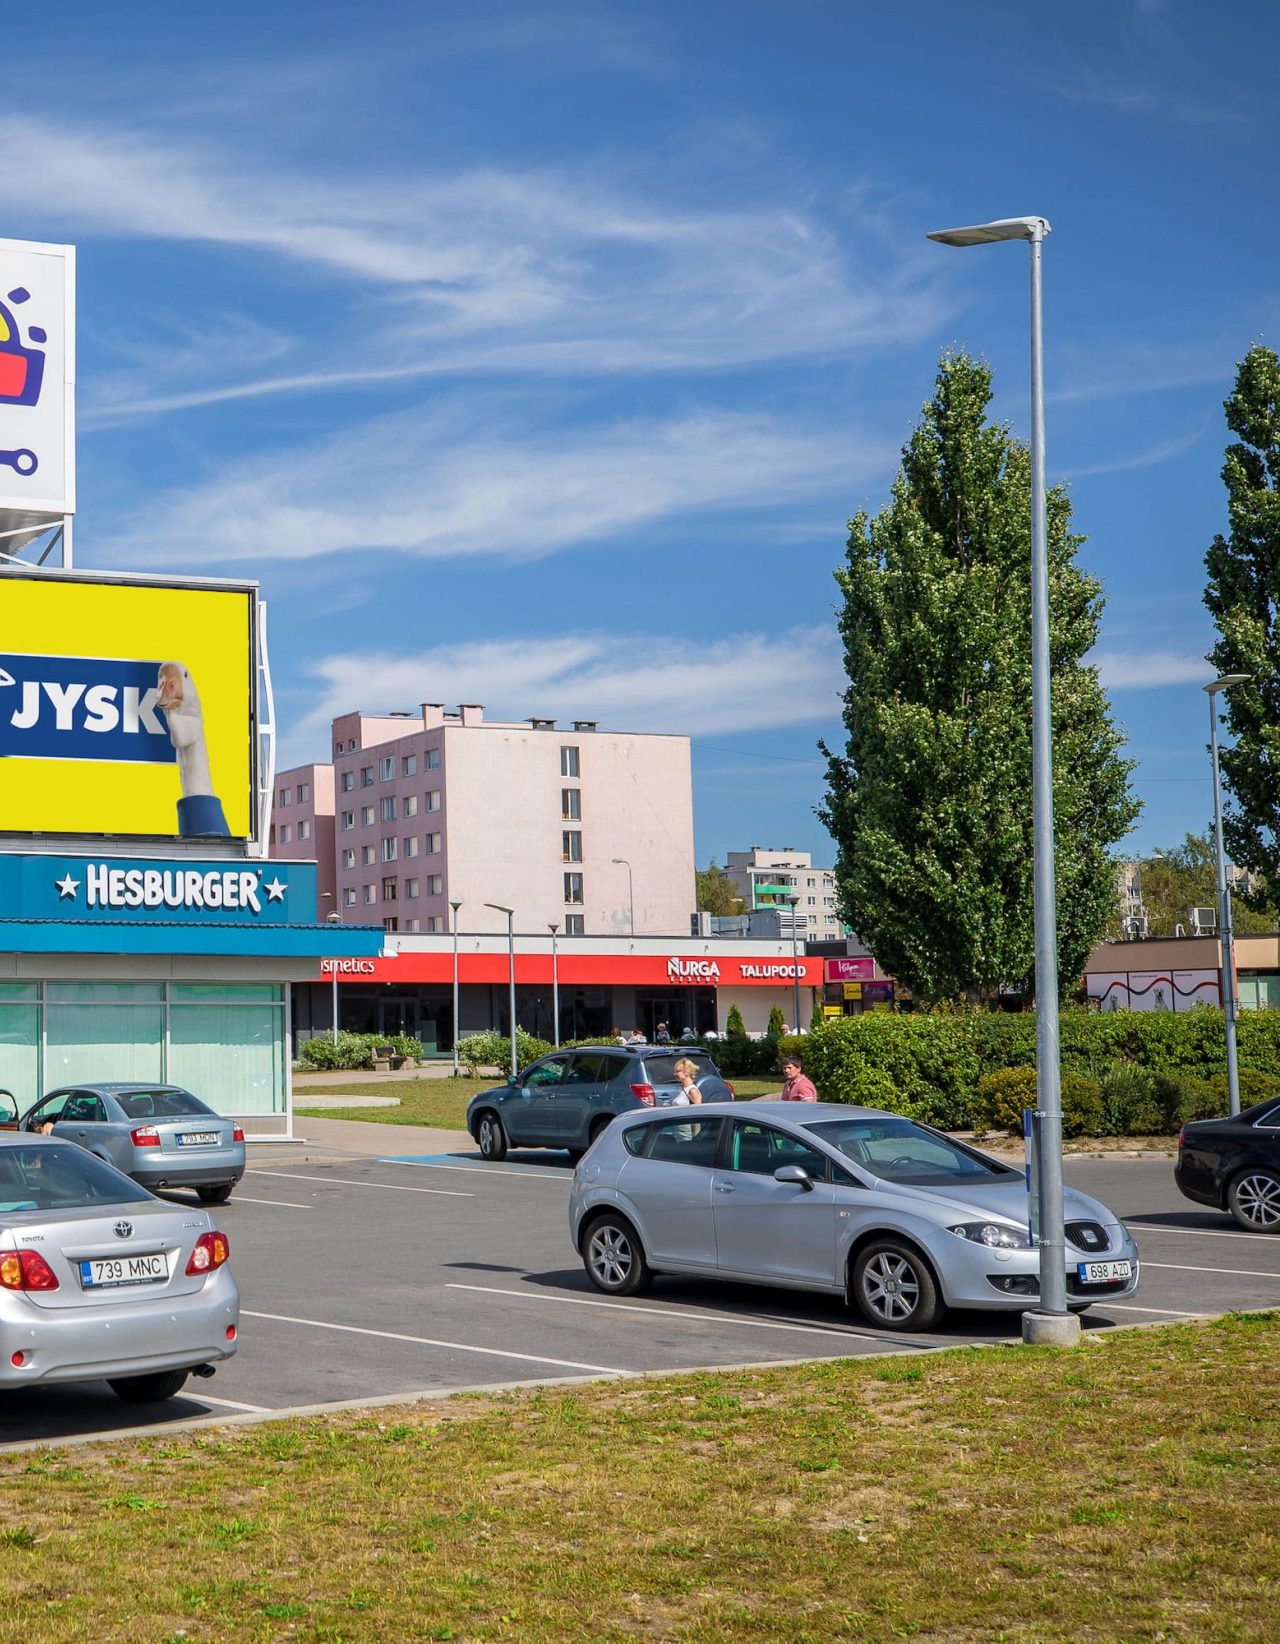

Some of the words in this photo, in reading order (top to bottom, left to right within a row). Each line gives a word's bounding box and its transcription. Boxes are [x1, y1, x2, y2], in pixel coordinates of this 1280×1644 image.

[10, 681, 167, 734] JYSK
[87, 863, 262, 912] HESBURGER
[320, 957, 375, 973] smetics
[667, 957, 720, 976] NURGA
[740, 964, 807, 977] TALUPOOD
[95, 1261, 122, 1281] 739
[129, 1258, 161, 1277] MNC
[1090, 1264, 1109, 1278] 698
